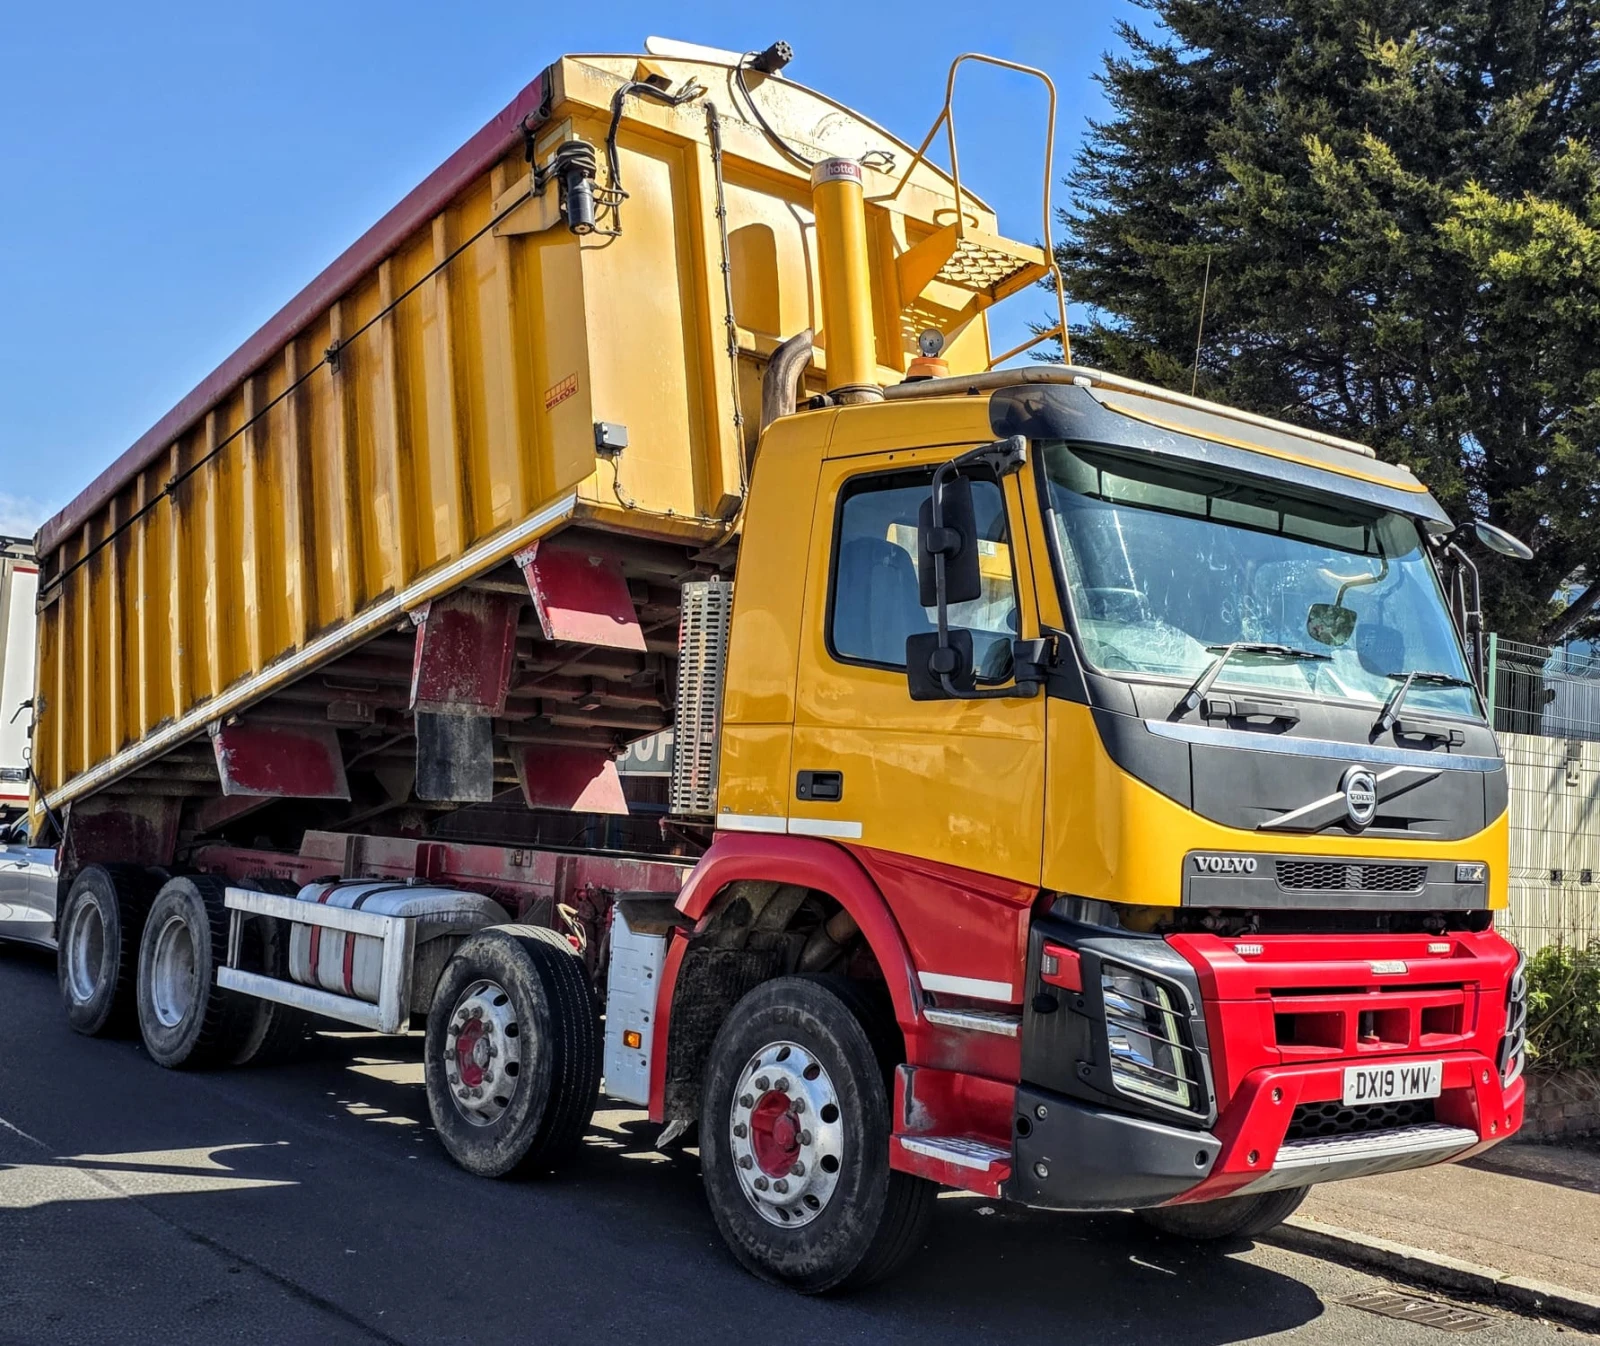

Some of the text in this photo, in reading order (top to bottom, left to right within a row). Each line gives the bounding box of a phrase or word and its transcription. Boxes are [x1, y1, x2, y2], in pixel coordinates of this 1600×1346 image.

[545, 385, 577, 410] WILCOX
[1350, 793, 1374, 802] VOLVO
[1194, 855, 1258, 873] VOLVO
[1459, 867, 1484, 880] FMX
[1355, 1066, 1432, 1100] DX19 YMV
